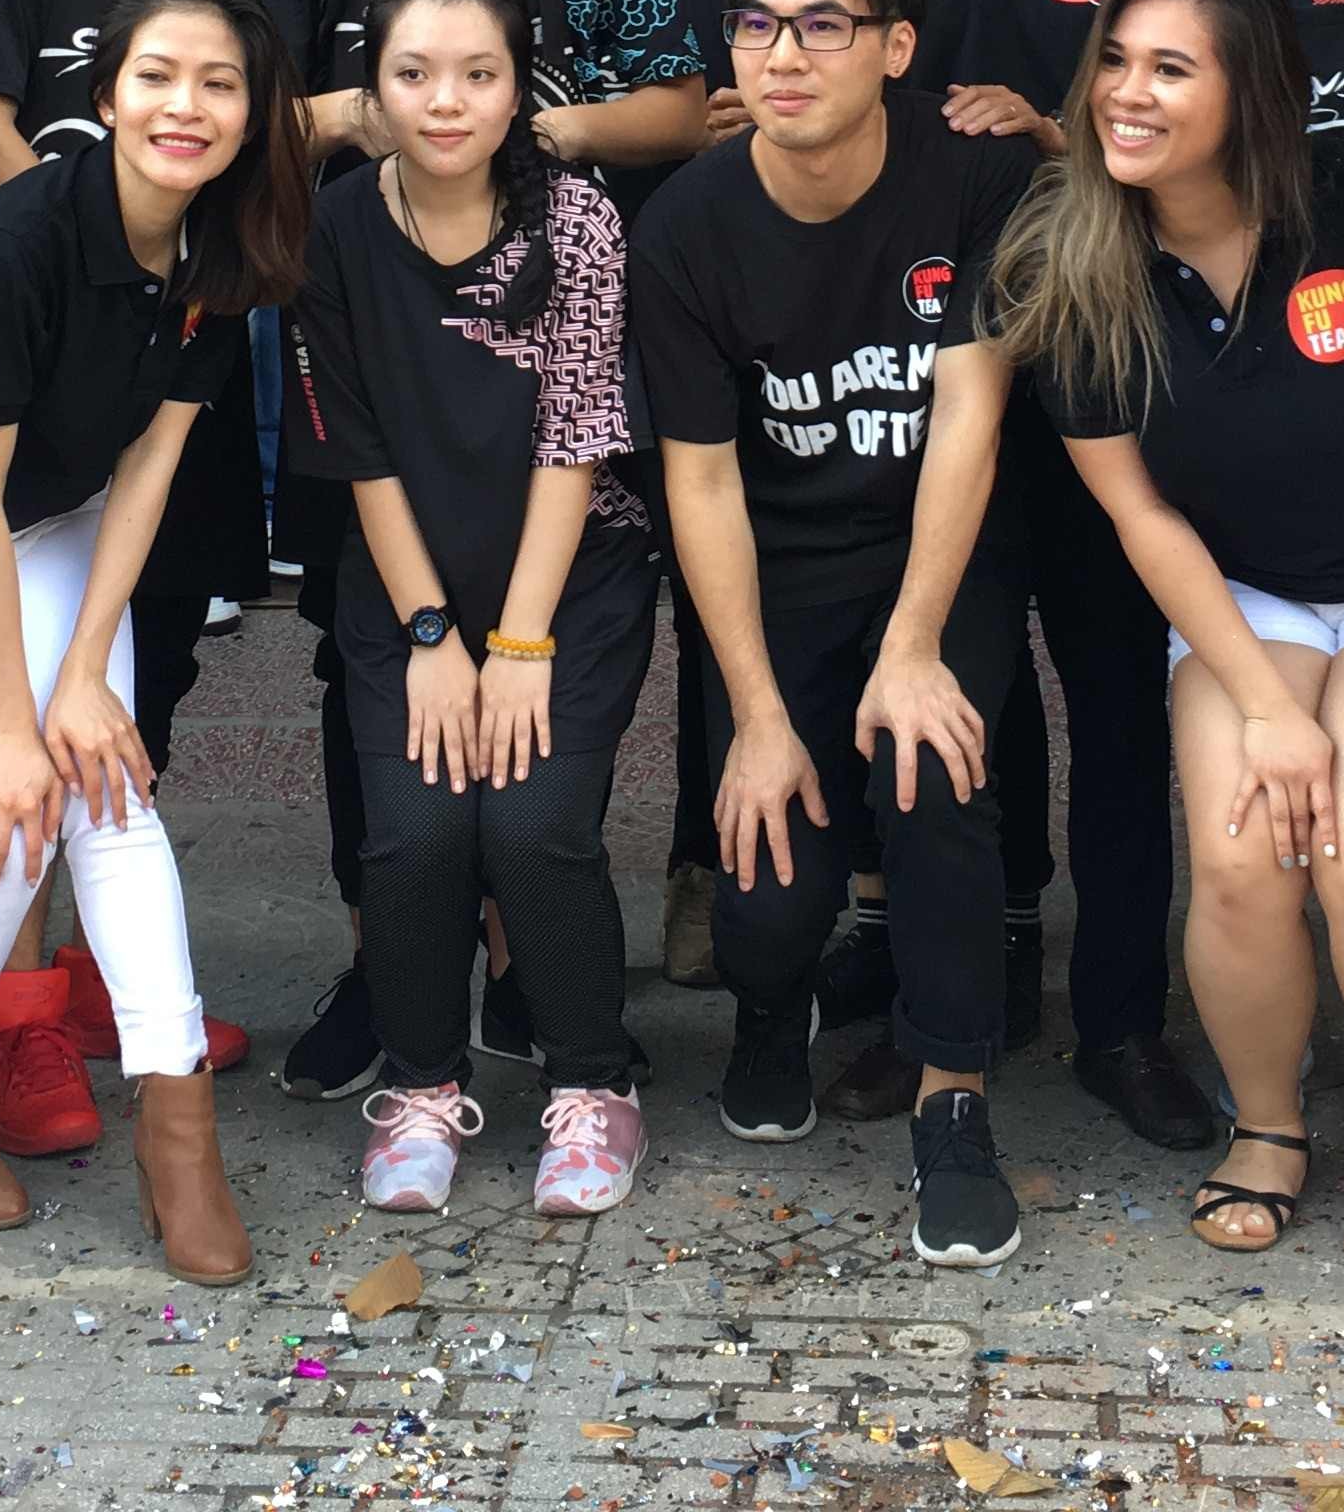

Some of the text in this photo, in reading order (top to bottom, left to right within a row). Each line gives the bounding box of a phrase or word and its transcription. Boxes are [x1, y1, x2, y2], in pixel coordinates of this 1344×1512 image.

[912, 265, 953, 285] KUNG
[914, 283, 934, 299] FU
[916, 298, 943, 315] TEA
[1301, 308, 1333, 334] FU
[295, 346, 311, 375] TEA
[831, 345, 905, 402] ARE
[907, 342, 937, 391] M
[846, 409, 887, 457] OF
[889, 405, 927, 458] TE
